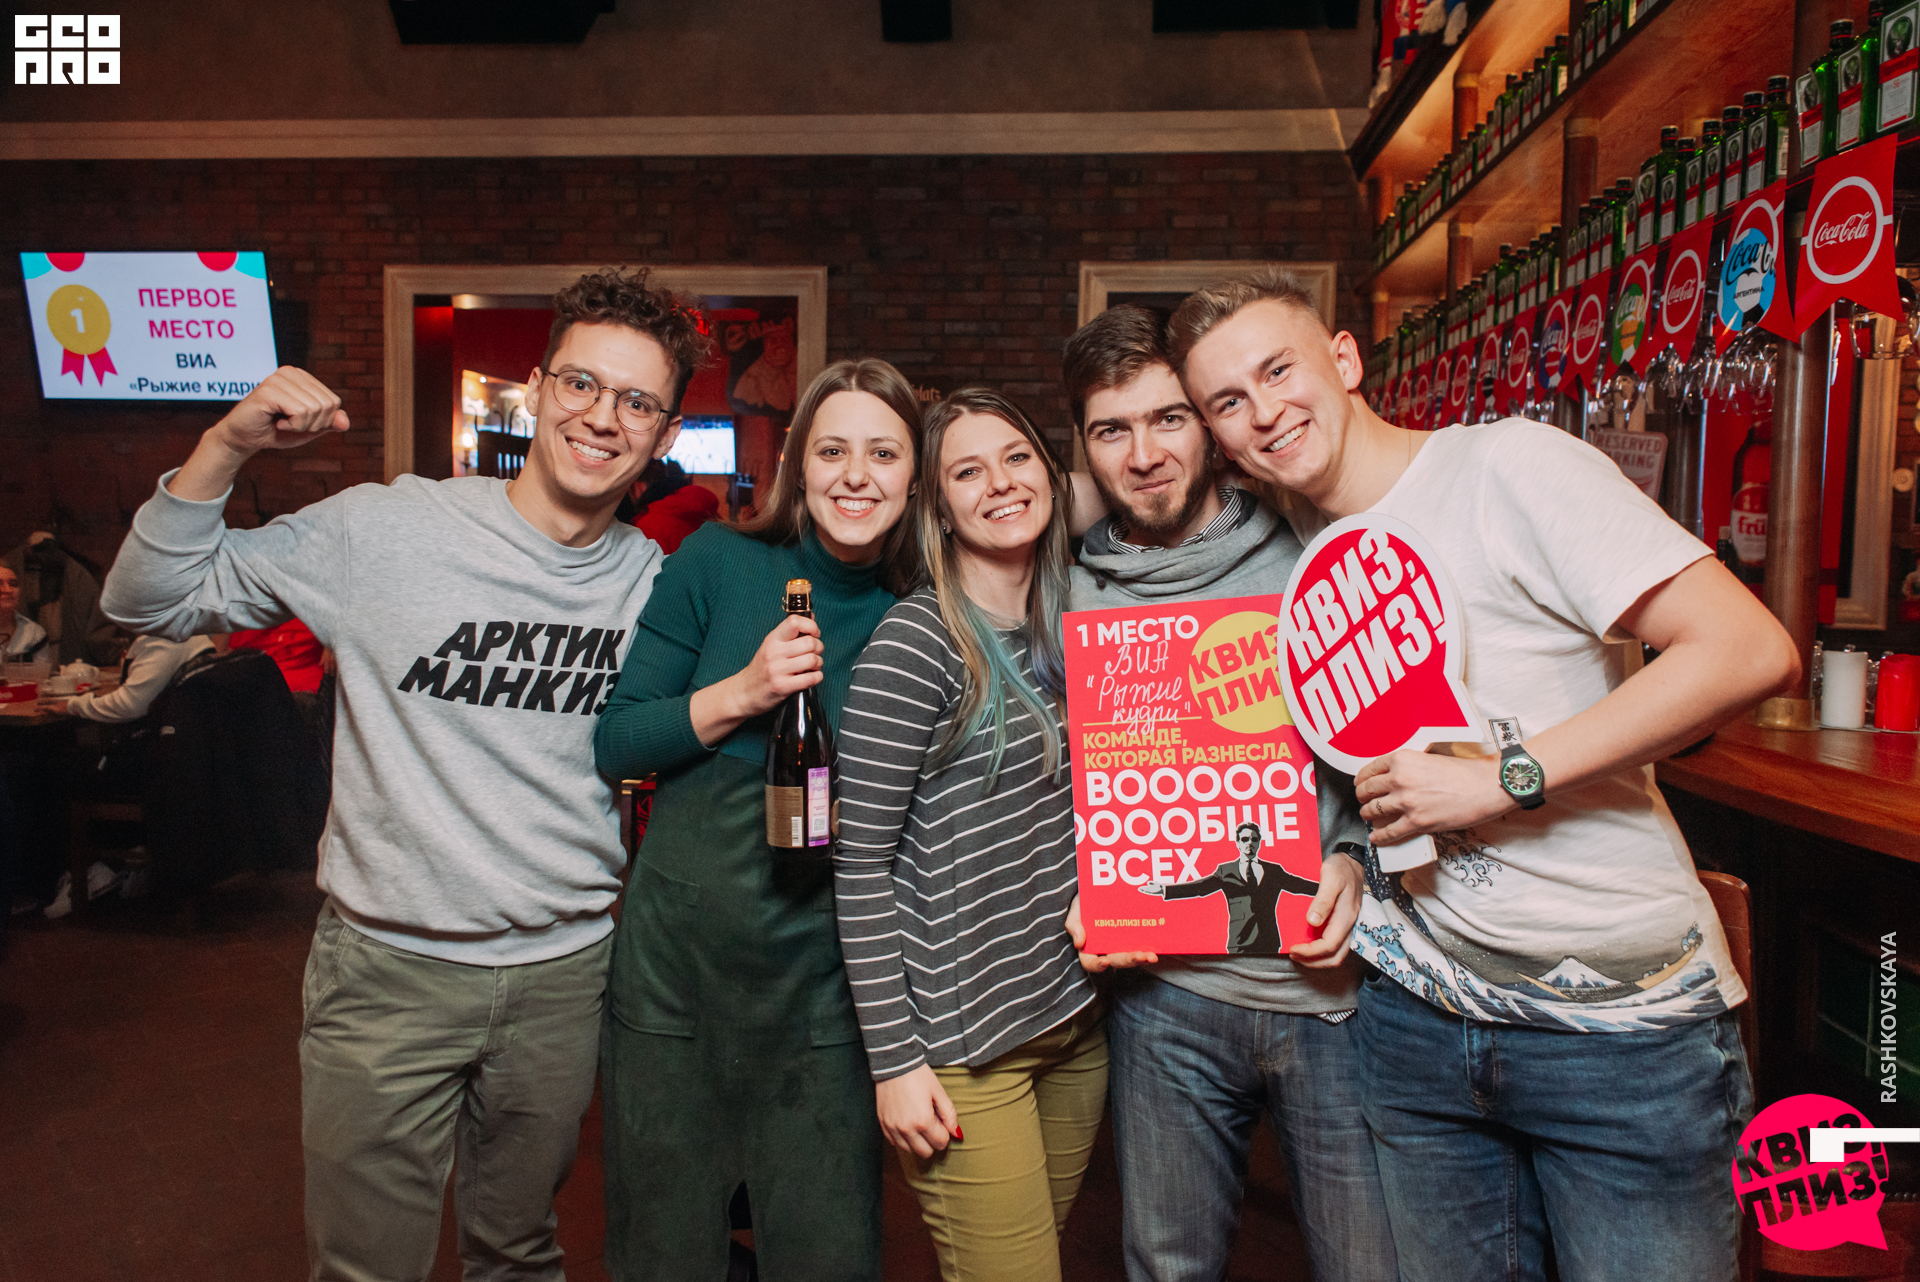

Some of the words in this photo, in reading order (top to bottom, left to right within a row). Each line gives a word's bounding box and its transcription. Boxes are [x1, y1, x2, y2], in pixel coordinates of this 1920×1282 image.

[1814, 211, 1873, 249] Coca-Cola
[138, 288, 237, 308] ПЕРВОЕ
[1733, 286, 1765, 299] АРГЕНТИНА
[70, 308, 85, 333] 1
[149, 320, 234, 339] МЕСТО
[176, 353, 216, 368] ВИА
[129, 377, 201, 393] «Рыжие
[1606, 451, 1655, 469] RKING
[1287, 528, 1416, 674] КВИЗ,
[1077, 624, 1089, 647] 1
[1097, 615, 1199, 646] МЕСТО
[433, 620, 626, 671] АРКТИК
[1105, 640, 1169, 676] ВИА
[1299, 573, 1446, 743] ПЛИЗ!
[1197, 665, 1281, 717] ПЛИ
[1083, 727, 1188, 750] КОМАНДЕ,
[1084, 747, 1177, 769] КОТОРАЯ
[1182, 742, 1292, 765] РАЗНЕСЛА
[1091, 848, 1202, 886] ВСЕХ
